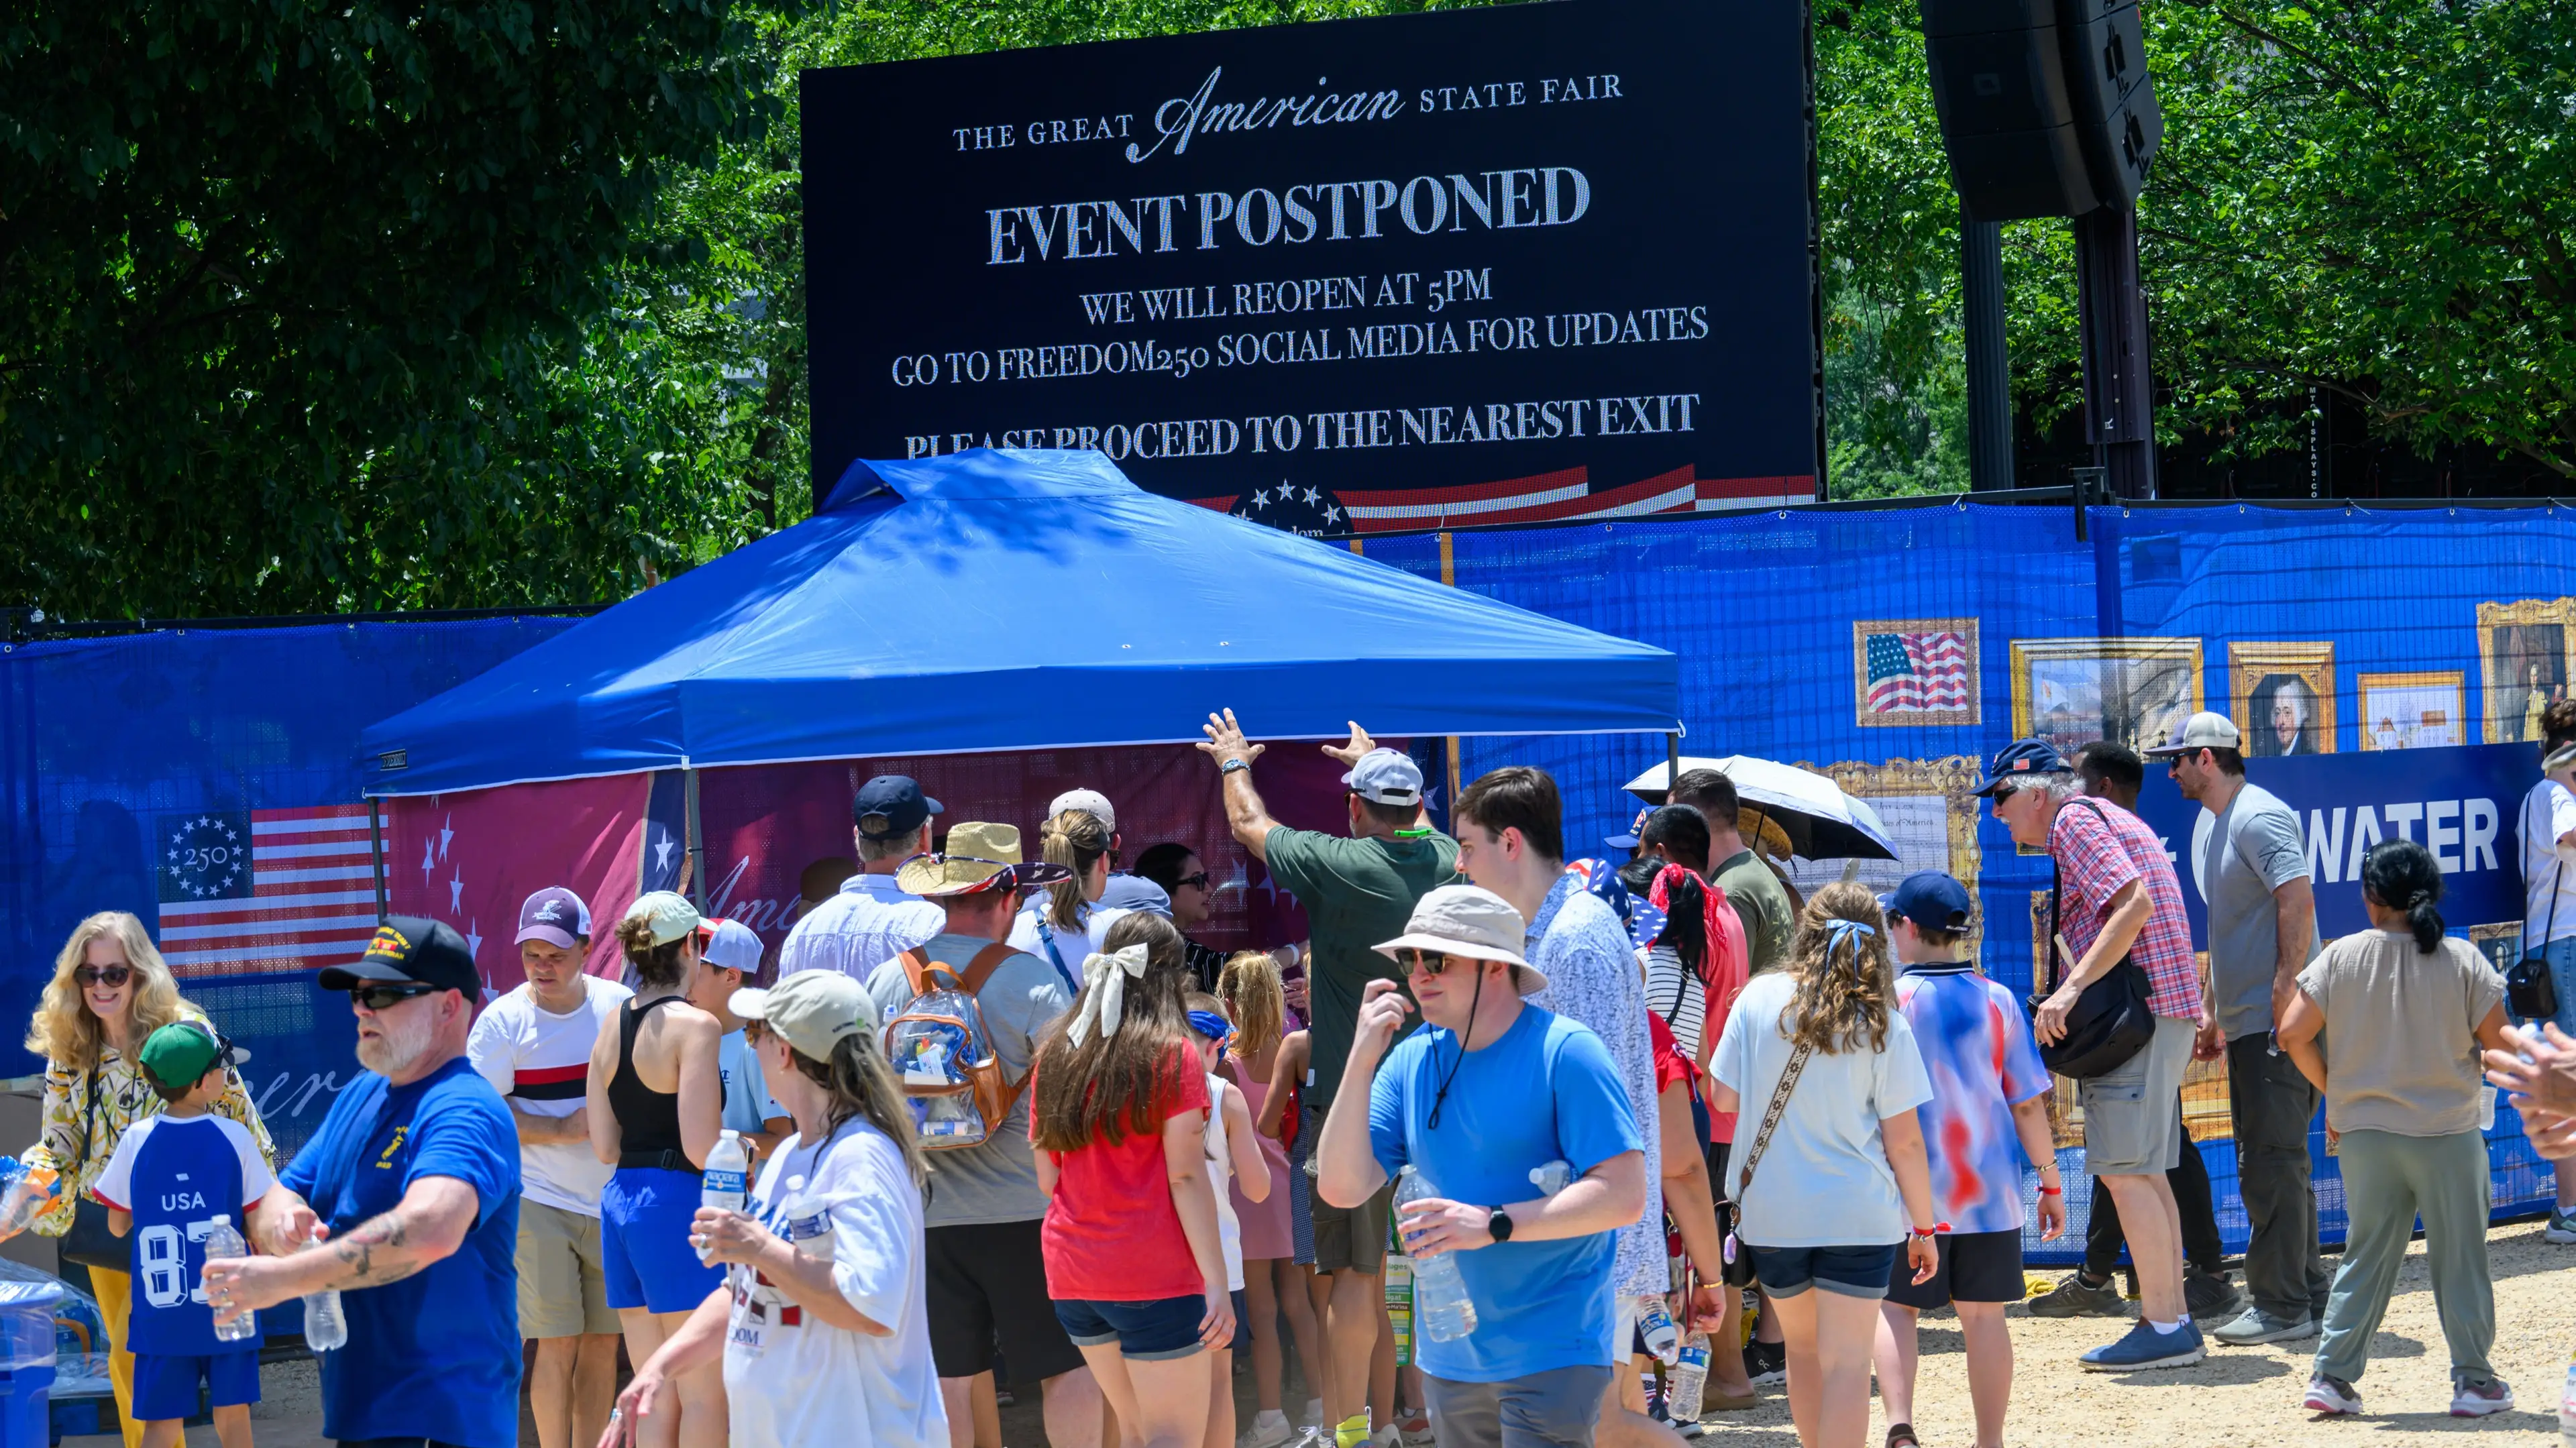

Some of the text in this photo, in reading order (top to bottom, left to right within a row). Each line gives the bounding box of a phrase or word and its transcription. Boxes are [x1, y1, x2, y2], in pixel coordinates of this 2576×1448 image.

[953, 66, 1623, 163] THE GREAT American STATE FAIR
[985, 167, 1590, 265] EVENT POSTPONED
[1079, 268, 1493, 325] WE WILL REOPEN AT 5PM
[892, 306, 1709, 386] GO TO FREEDOM250 SOCIAL MEDIA FOR UPDATES
[1052, 417, 1240, 461] PROCEED
[1245, 414, 1303, 452] TO
[1307, 409, 1393, 450] THE
[1397, 399, 1591, 446] NEAREST
[1597, 393, 1700, 436] EXIT
[184, 847, 227, 871] 250
[2296, 797, 2499, 885] WATER
[162, 1191, 206, 1211] USA
